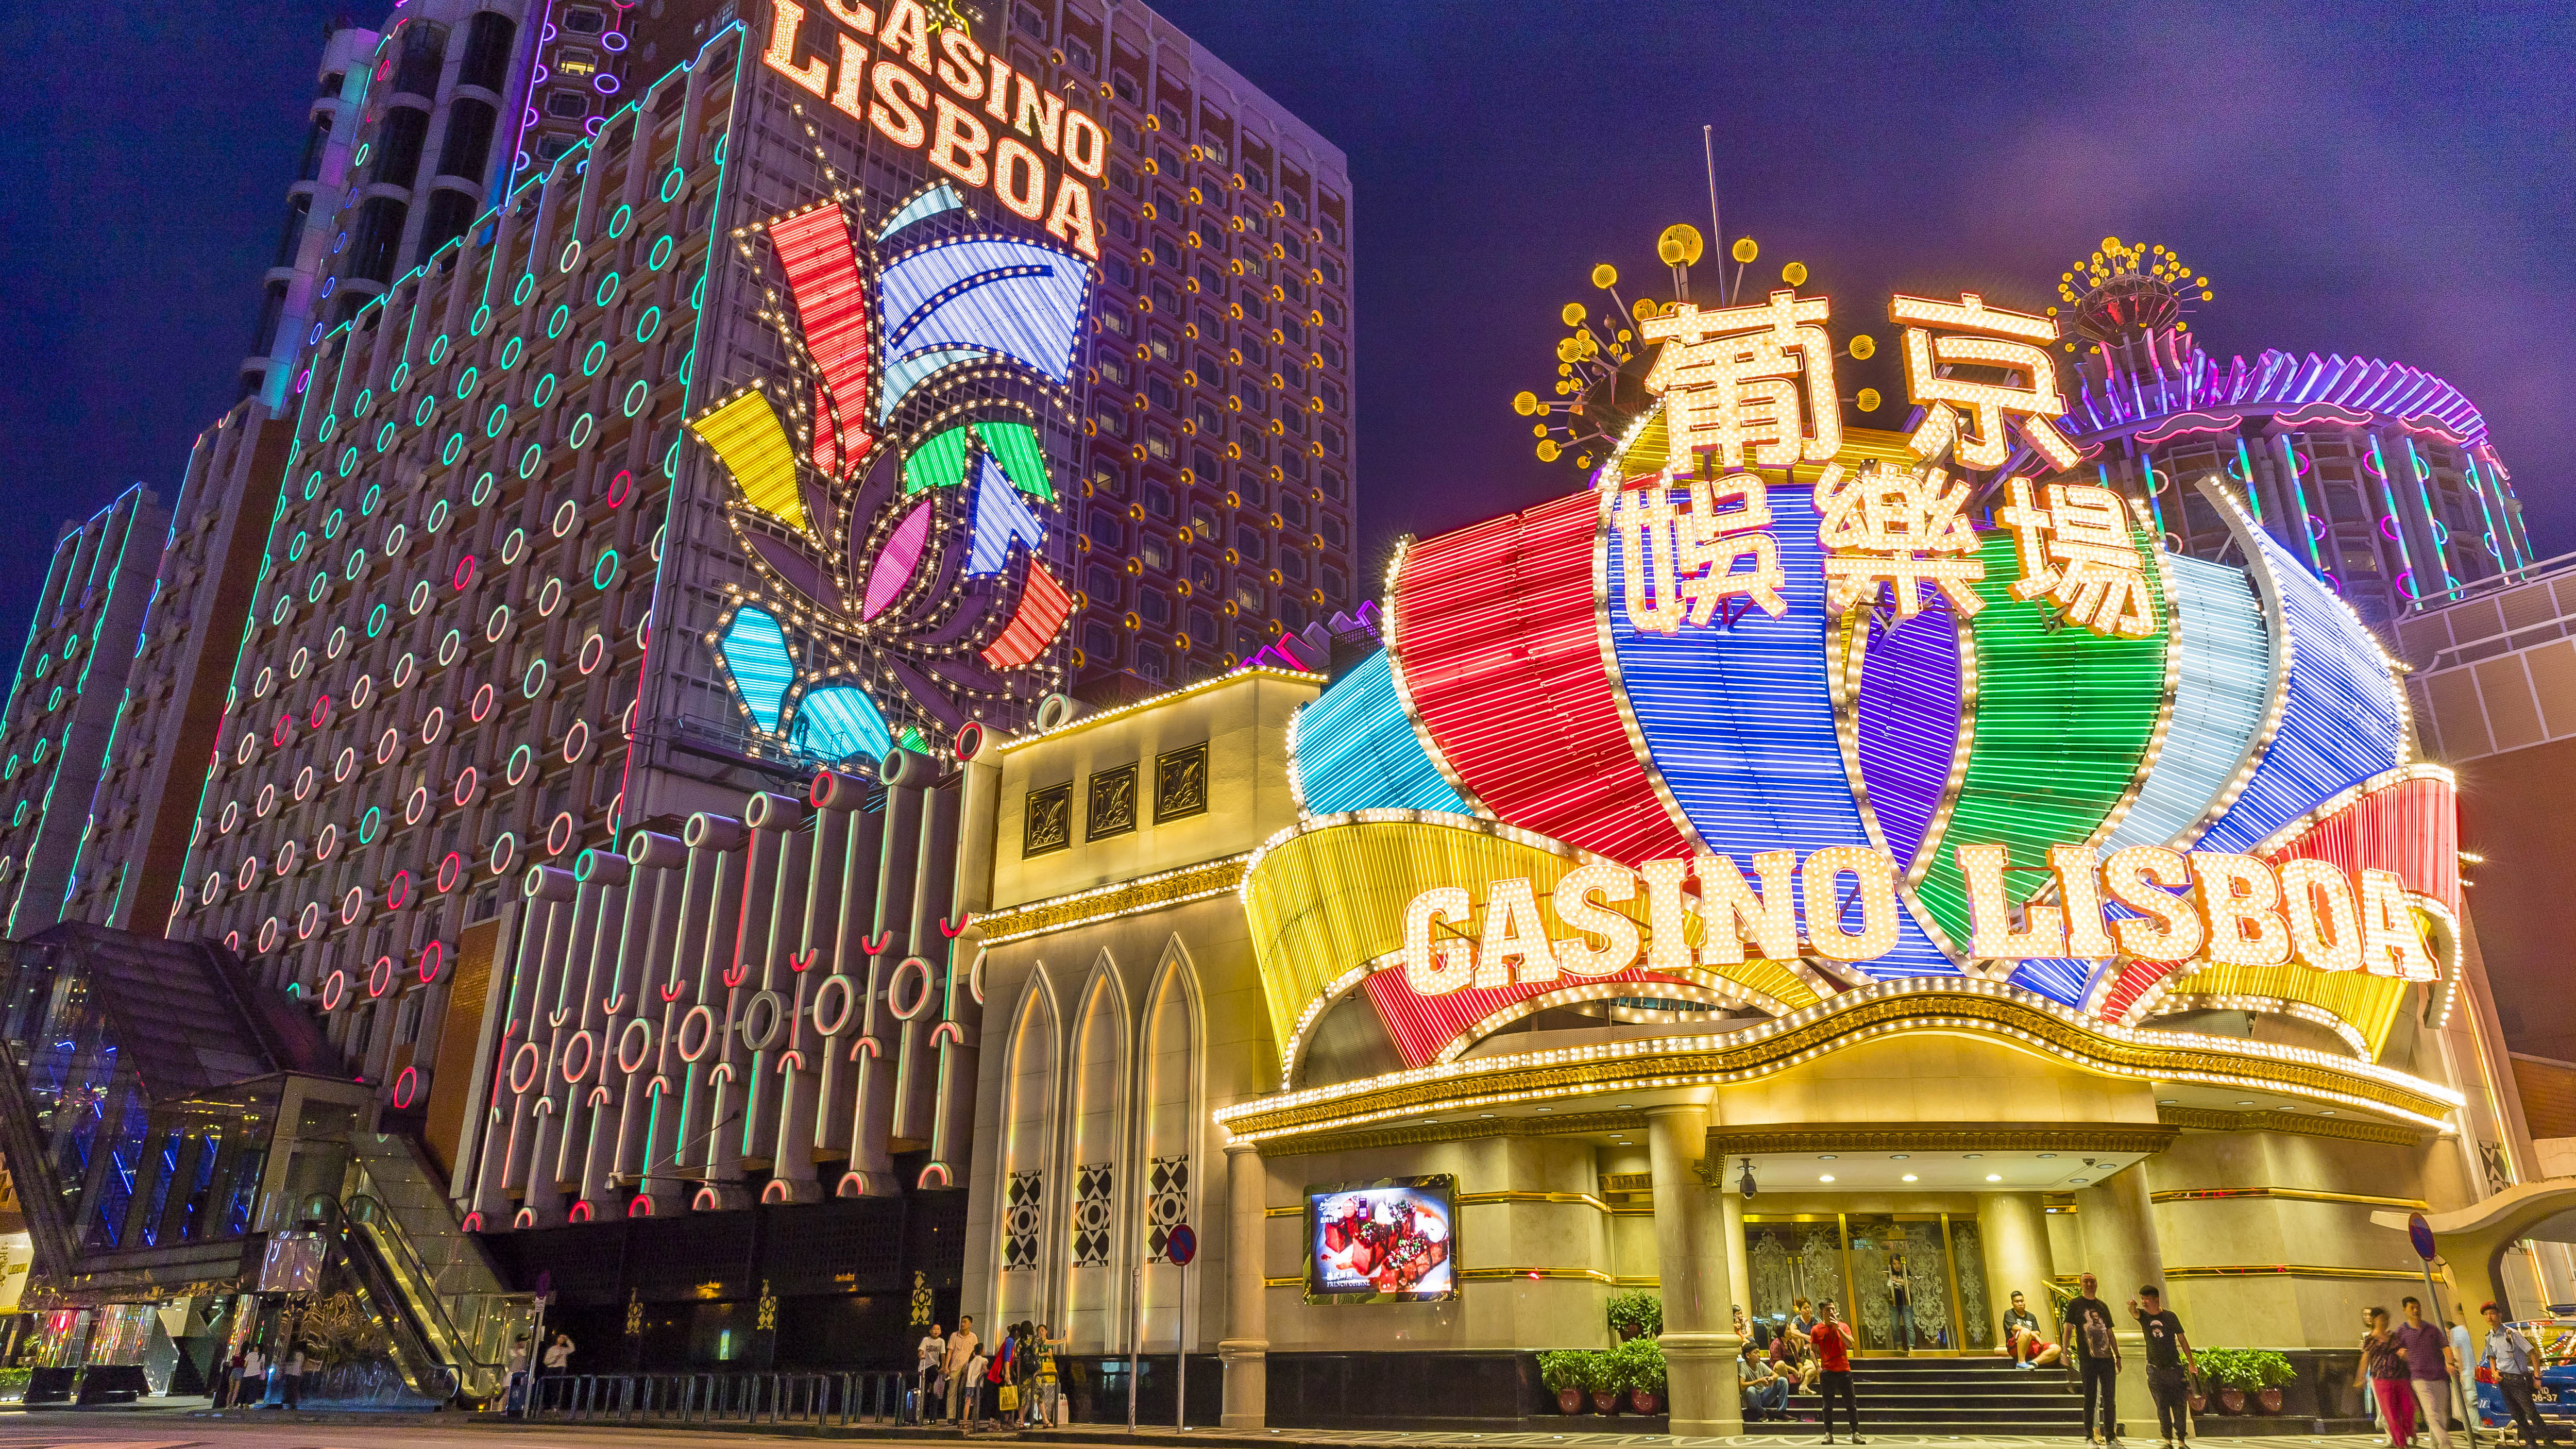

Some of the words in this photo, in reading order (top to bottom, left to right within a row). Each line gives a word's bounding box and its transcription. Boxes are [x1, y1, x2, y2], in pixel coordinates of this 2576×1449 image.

[763, 0, 1099, 260] LISBOA
[1642, 289, 2082, 480] 葡京
[1404, 846, 1901, 997] CASINO
[1954, 844, 2442, 982] LISBOA
